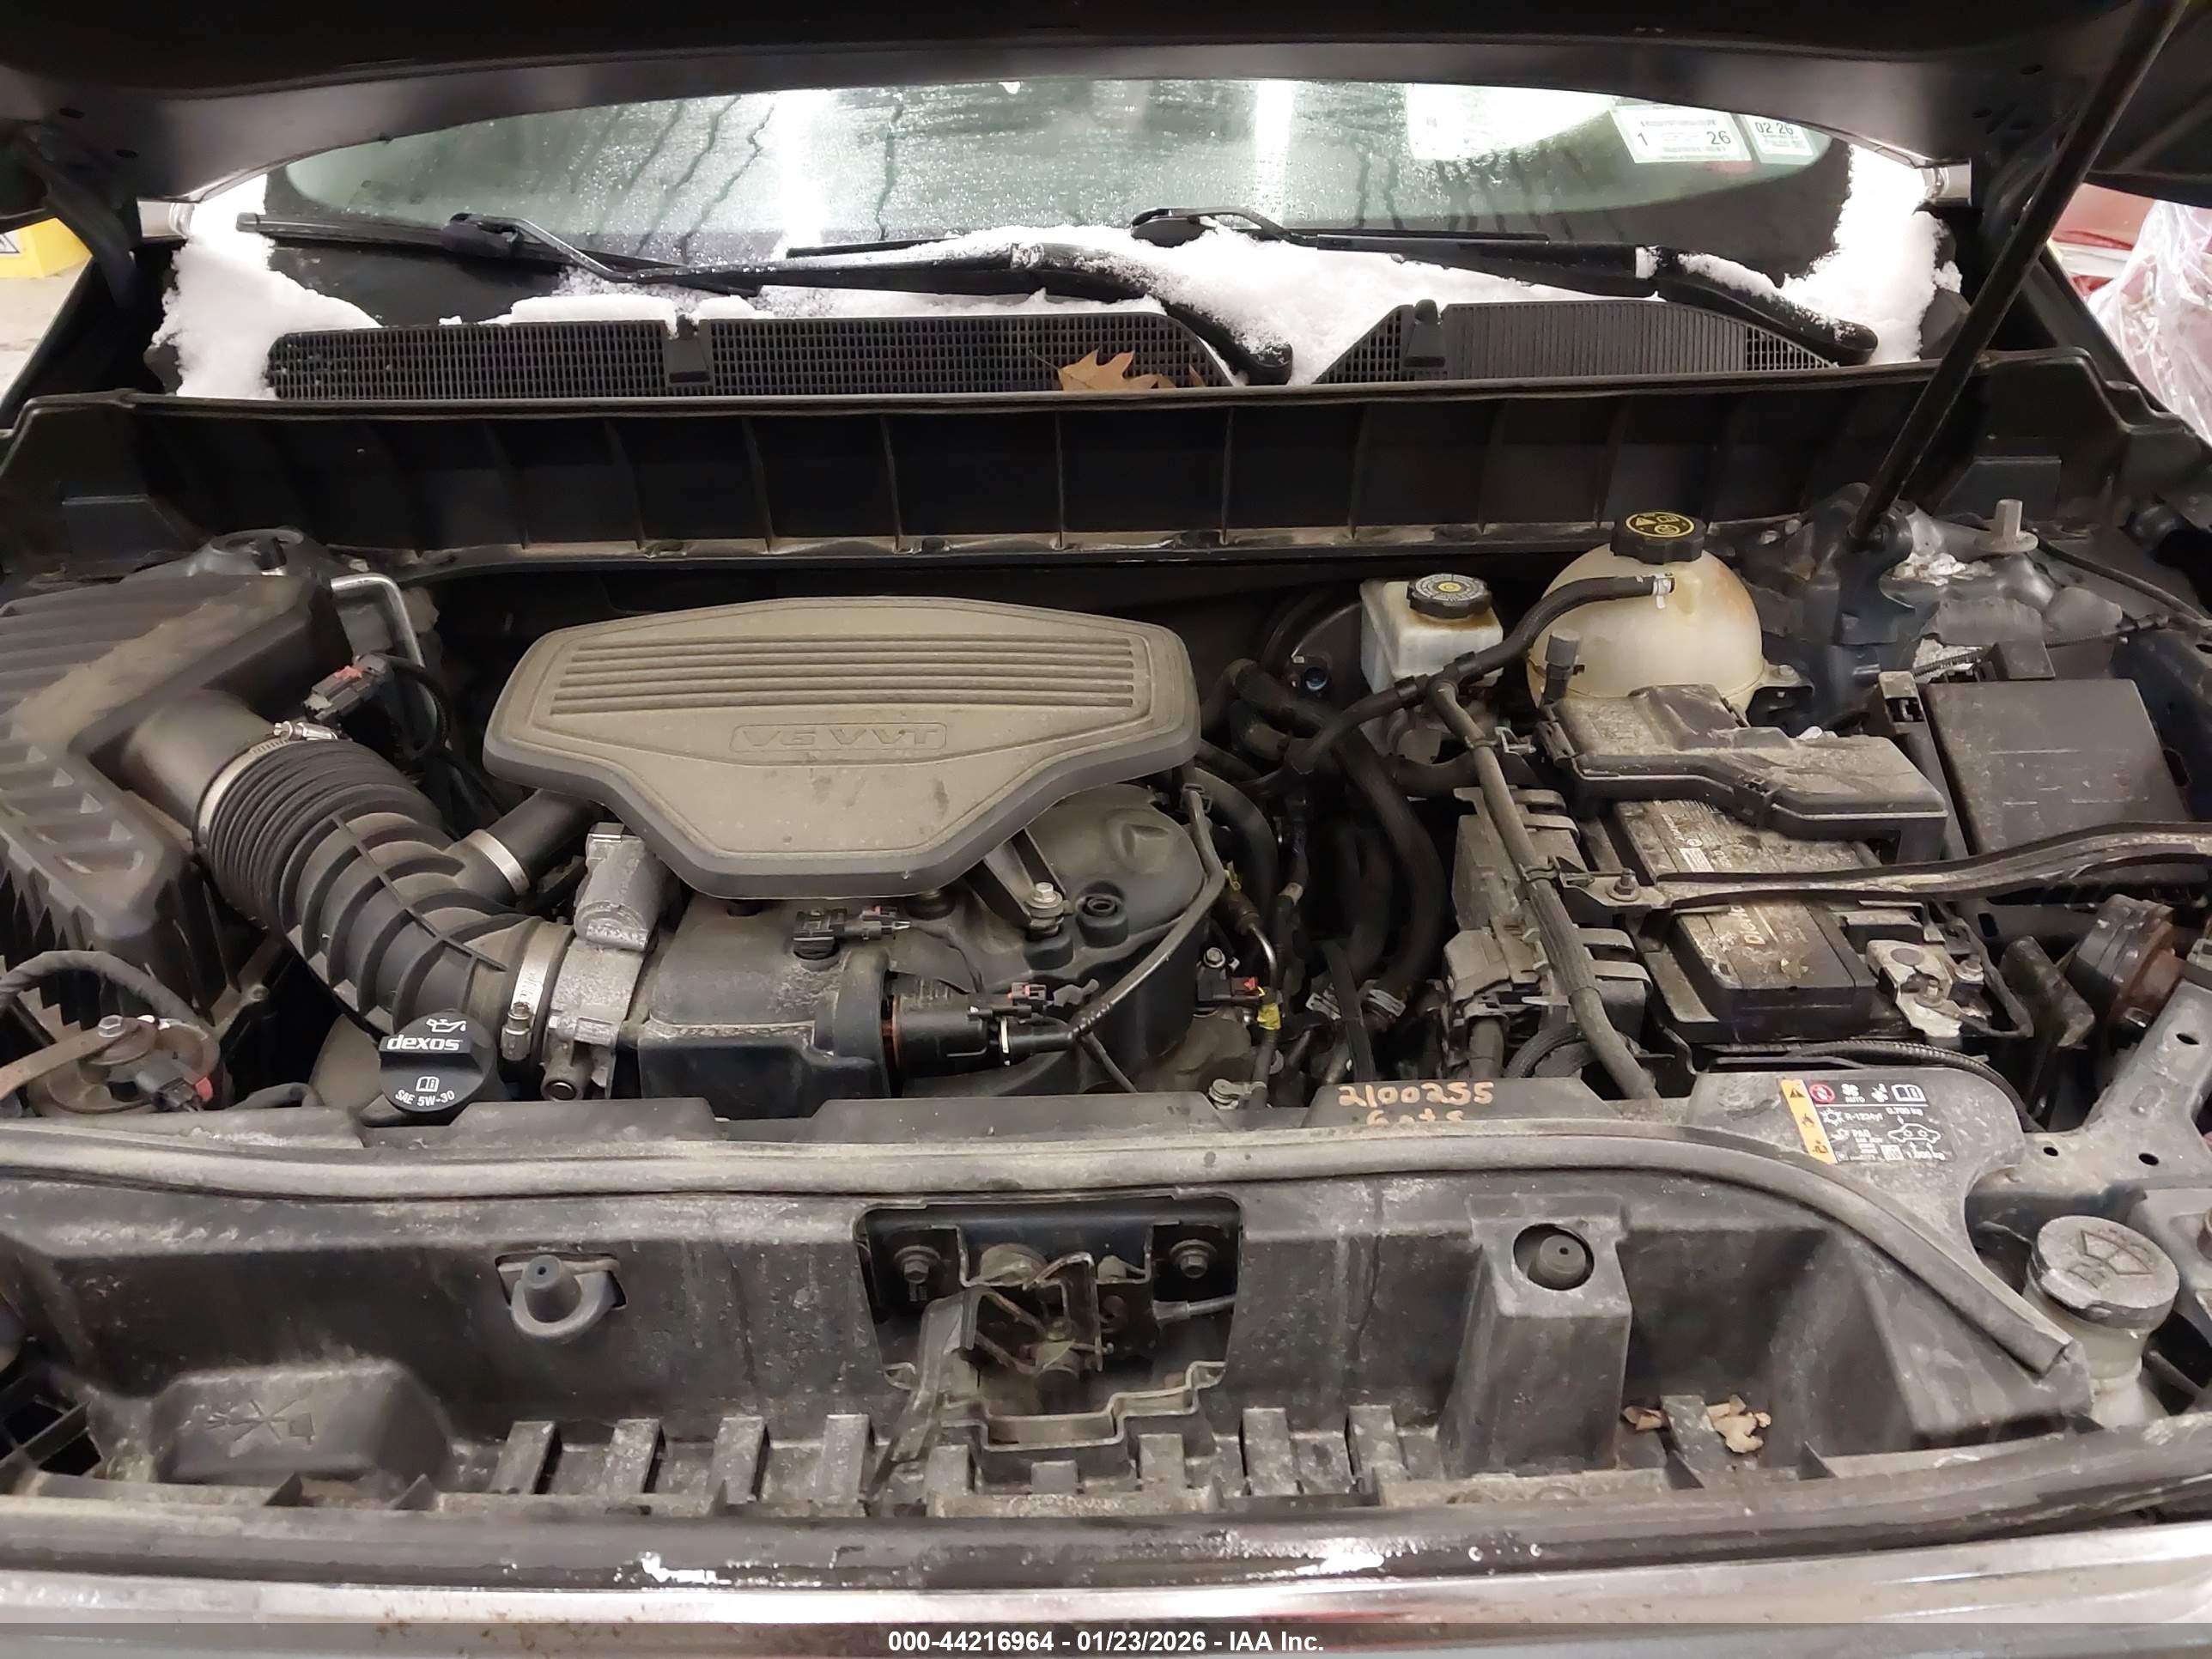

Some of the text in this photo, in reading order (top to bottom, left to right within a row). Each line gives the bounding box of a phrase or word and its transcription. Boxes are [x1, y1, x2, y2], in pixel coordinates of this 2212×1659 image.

[1754, 121, 1795, 136] 02 26
[1637, 131, 1649, 146] 1
[1706, 130, 1732, 145] 26
[742, 727, 939, 747] V6 VVT
[386, 1034, 463, 1051] dexos
[395, 1089, 456, 1107] SAE 5W-30
[1338, 1081, 1494, 1108] 2100255
